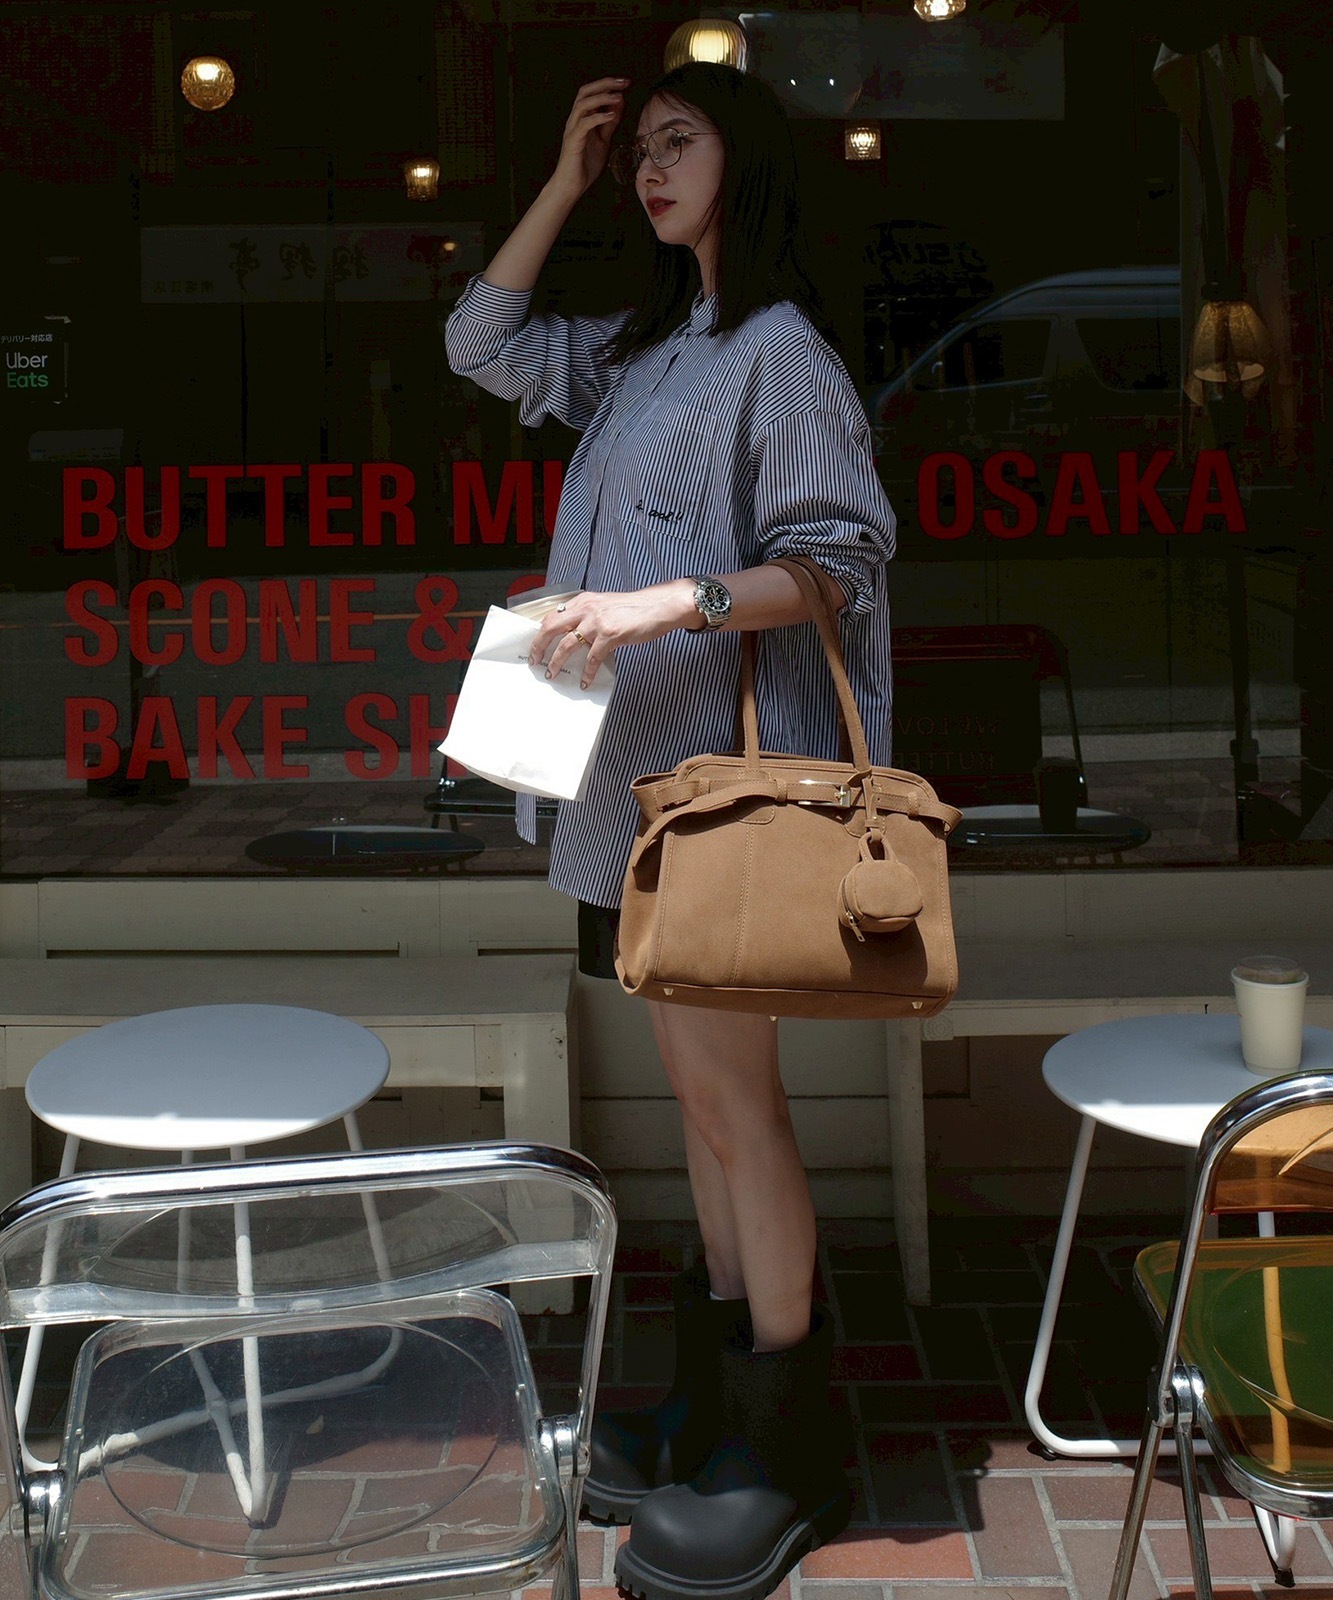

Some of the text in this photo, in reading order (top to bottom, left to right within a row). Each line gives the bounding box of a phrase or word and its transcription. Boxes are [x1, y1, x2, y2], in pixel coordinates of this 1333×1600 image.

[6, 352, 48, 368] Uber
[7, 372, 48, 388] Eats
[63, 462, 416, 550] BUTTER
[917, 450, 1248, 540] OSAKA
[64, 575, 474, 666] SCONE &
[64, 695, 310, 780] BAKE
